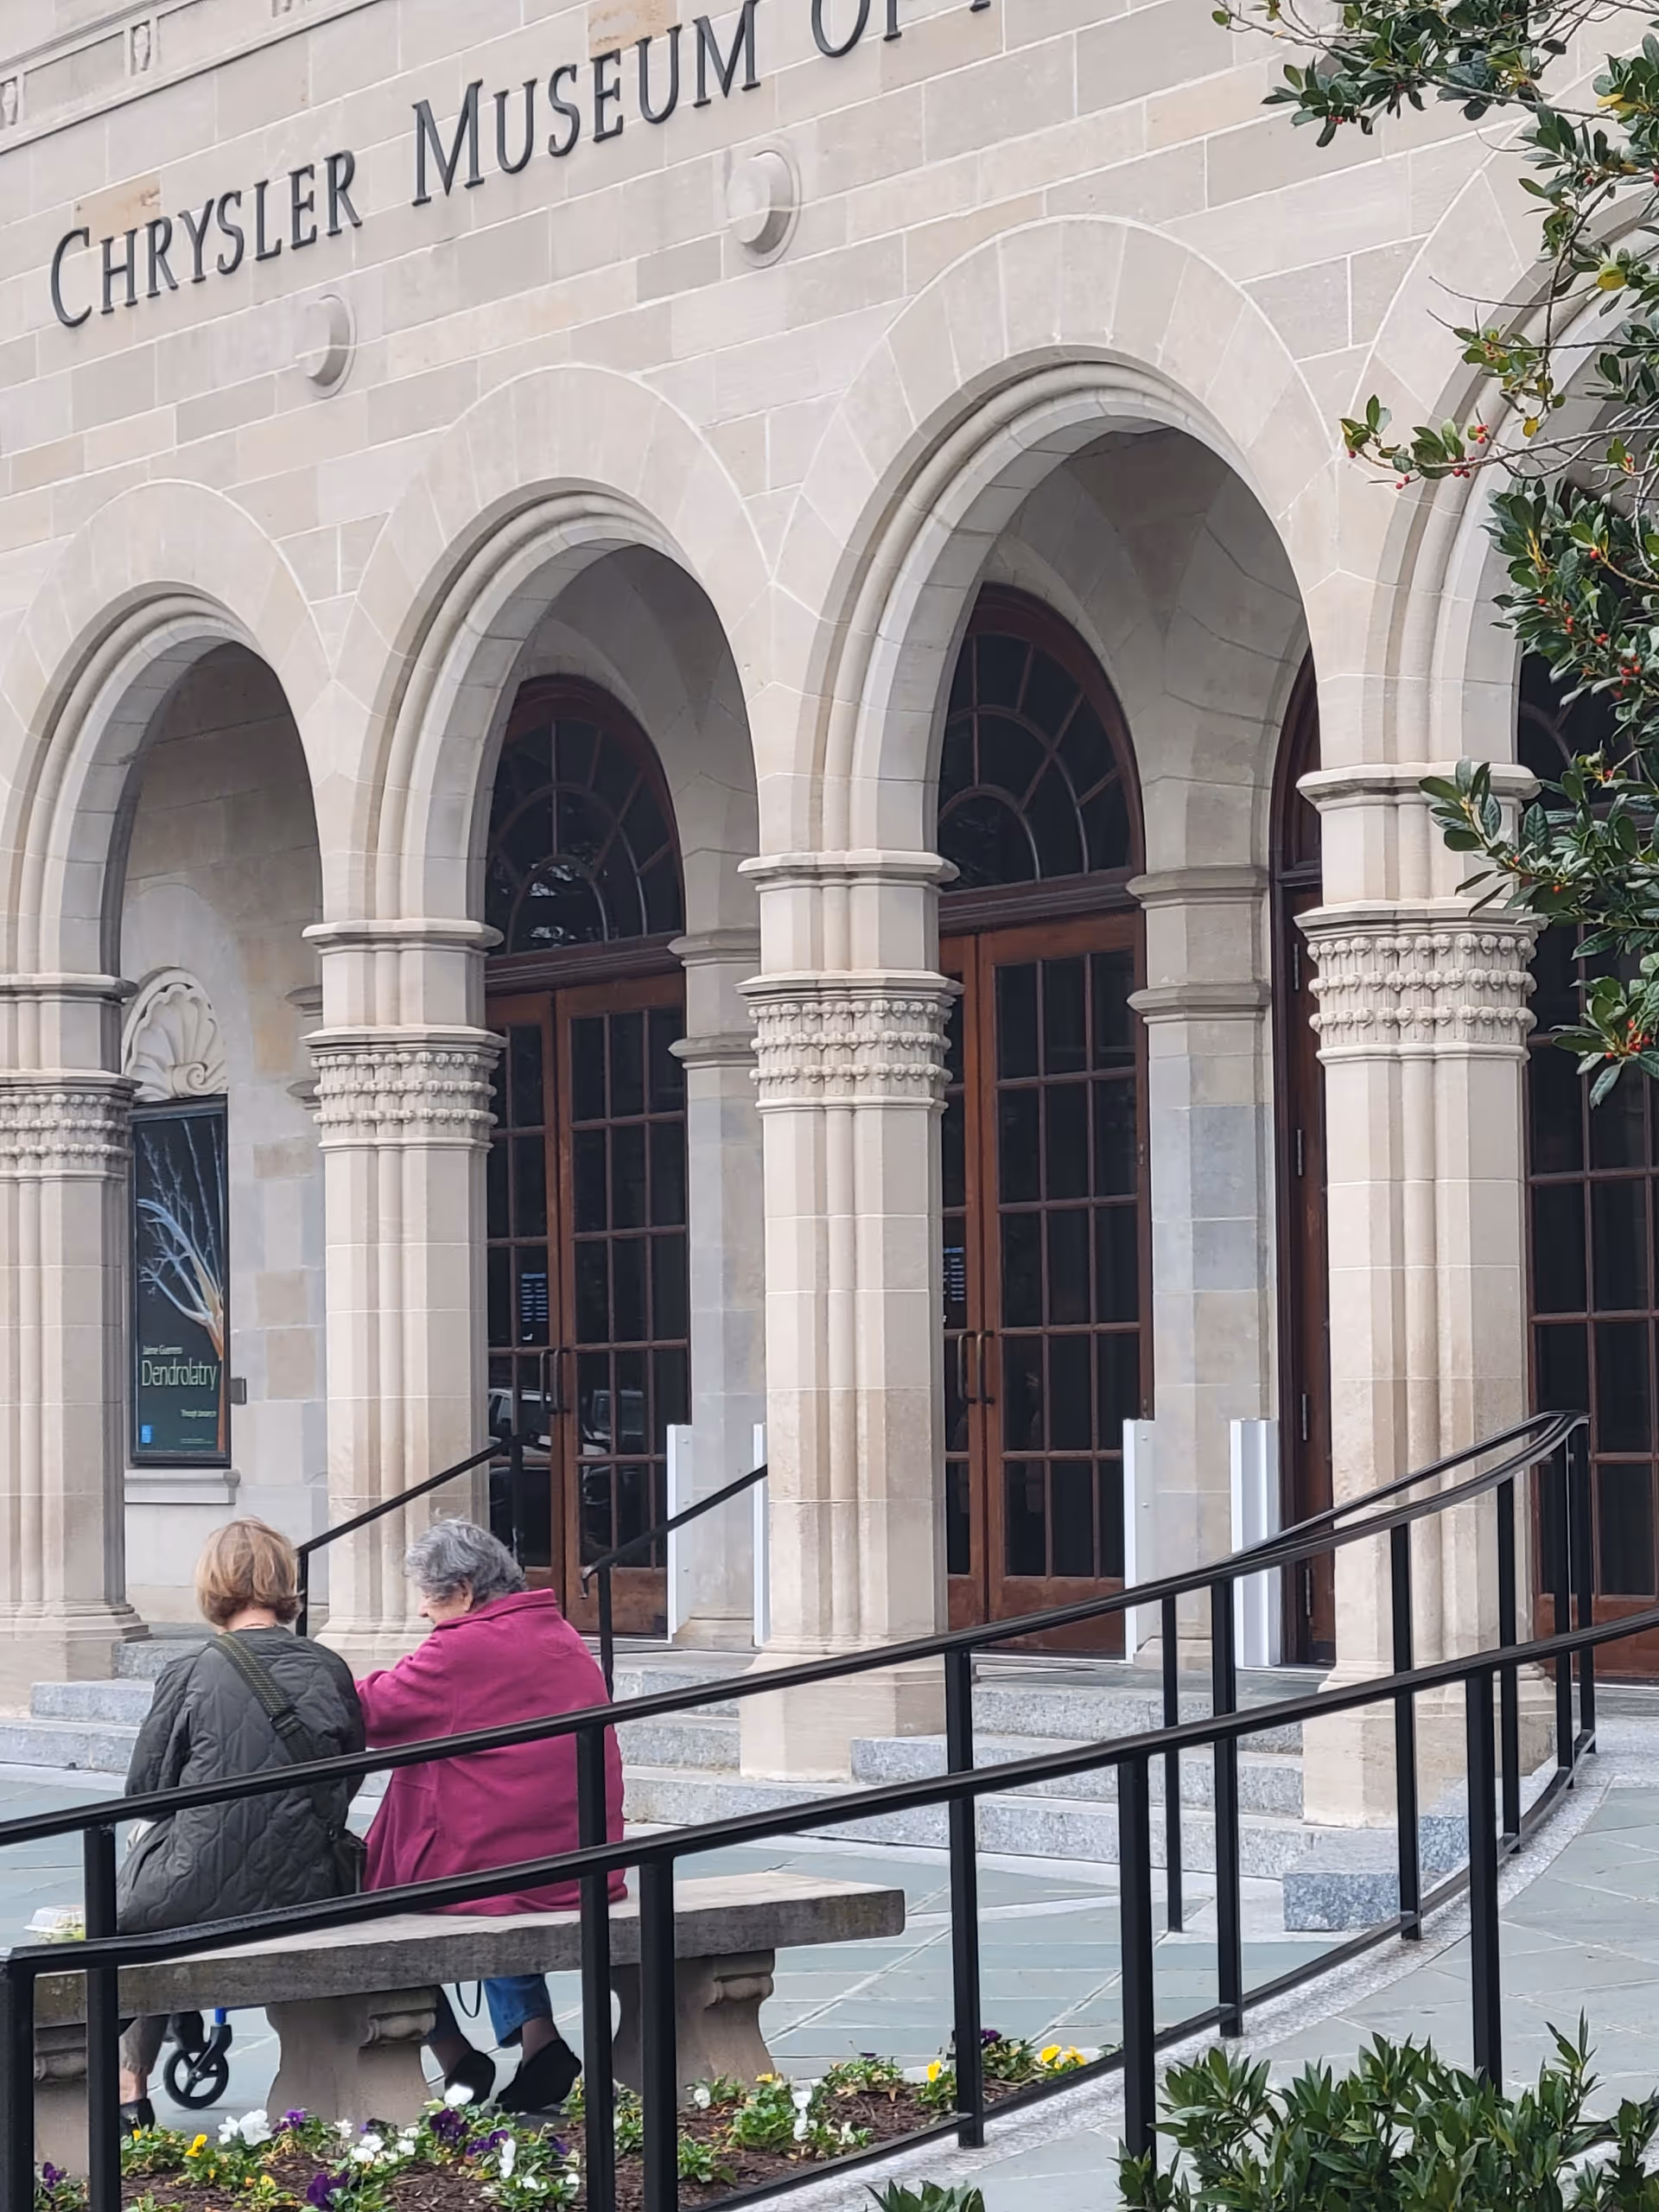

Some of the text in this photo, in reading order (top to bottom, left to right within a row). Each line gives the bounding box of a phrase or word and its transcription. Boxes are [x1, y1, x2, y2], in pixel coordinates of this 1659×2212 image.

[50, 149, 363, 328] CHRYSLER
[411, 0, 762, 207] MUSEUM
[142, 1357, 217, 1391] Dendrolatry
